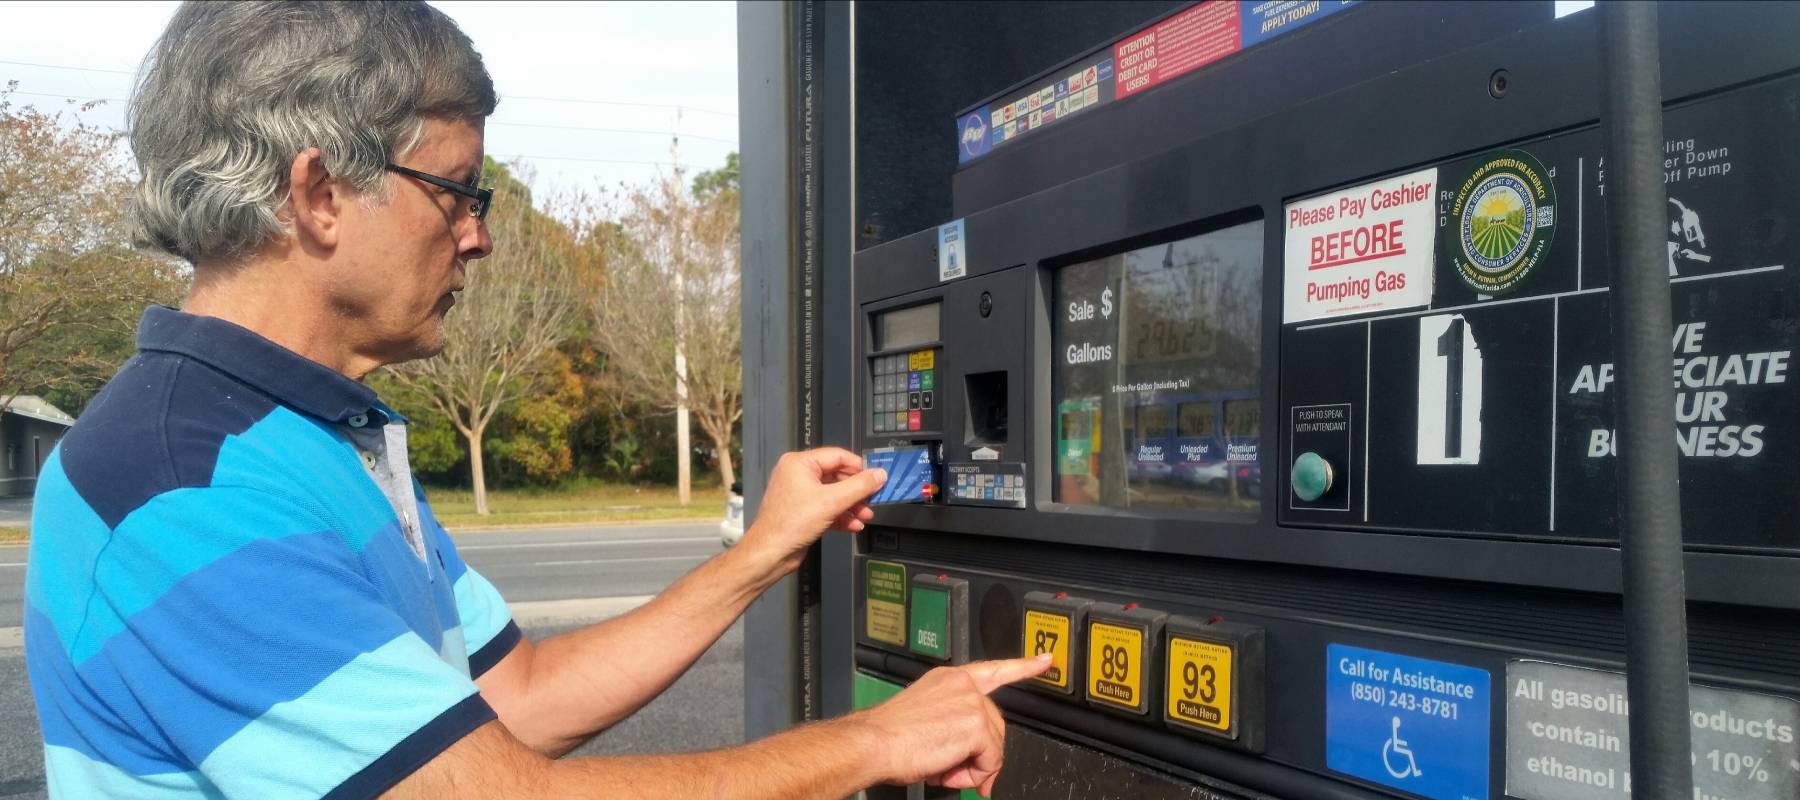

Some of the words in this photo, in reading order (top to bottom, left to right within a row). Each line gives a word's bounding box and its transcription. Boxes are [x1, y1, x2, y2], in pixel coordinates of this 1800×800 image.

[1261, 13, 1287, 33] APPLY
[1287, 1, 1320, 22] TODAY!
[1119, 32, 1155, 57] ATTENTION
[1120, 51, 1144, 69] CREDIT
[1144, 46, 1155, 58] OR
[1118, 65, 1138, 82] DEBIT
[1138, 58, 1158, 74] CARD
[1126, 73, 1150, 92] USERS!
[1686, 146, 1729, 165] Down
[1688, 162, 1732, 179] Pump
[1453, 179, 1473, 216] INSPECTED
[1473, 167, 1485, 181] AND
[1484, 159, 1515, 173] APPROVED
[1515, 160, 1527, 172] FOR
[1525, 168, 1546, 200] ACCURACY
[1290, 204, 1335, 229] Please
[1340, 197, 1367, 219] Pay
[1370, 181, 1432, 211] Cashier
[1472, 178, 1504, 204] DEPARTMENT
[1513, 181, 1532, 224] AGRICULTURE
[1310, 219, 1404, 265] BEFORE
[1474, 251, 1504, 267] CONSUMER
[1505, 232, 1529, 263] SERVICES
[1307, 276, 1370, 303] Pumping
[1375, 270, 1406, 293] Gas
[1069, 300, 1094, 322] Sale
[1101, 285, 1113, 320] $
[1067, 342, 1112, 365] Gallons
[1136, 383, 1153, 391] Gallon
[1437, 317, 1465, 458] 1
[1295, 423, 1311, 432] WITH
[1311, 421, 1347, 431] ATTENDANT
[1299, 411, 1315, 420] PUSH
[1316, 410, 1324, 419] TO
[1324, 409, 1344, 419] SPEAK
[1180, 444, 1208, 453] Unleaded
[1187, 452, 1201, 461] Plus
[1226, 451, 1257, 461] Unleaded
[1227, 443, 1257, 453] Premium
[918, 629, 939, 649] DIESEL
[1034, 629, 1059, 657] 87
[1101, 644, 1129, 683] 89
[1098, 683, 1114, 695] Push
[1115, 686, 1130, 699] Here
[1182, 661, 1217, 704] 93
[1339, 657, 1365, 678] Call
[1368, 662, 1390, 682] for
[1392, 667, 1474, 699] Assistance
[1351, 681, 1386, 707] (850)
[1389, 689, 1459, 720] 243-8781
[1515, 679, 1544, 701] All
[1551, 688, 1629, 716] gasoli
[1180, 702, 1198, 717] Push
[1199, 707, 1218, 721] Here
[1531, 721, 1620, 752] contain
[1706, 749, 1769, 782] 10%
[1527, 757, 1615, 789] ethanol
